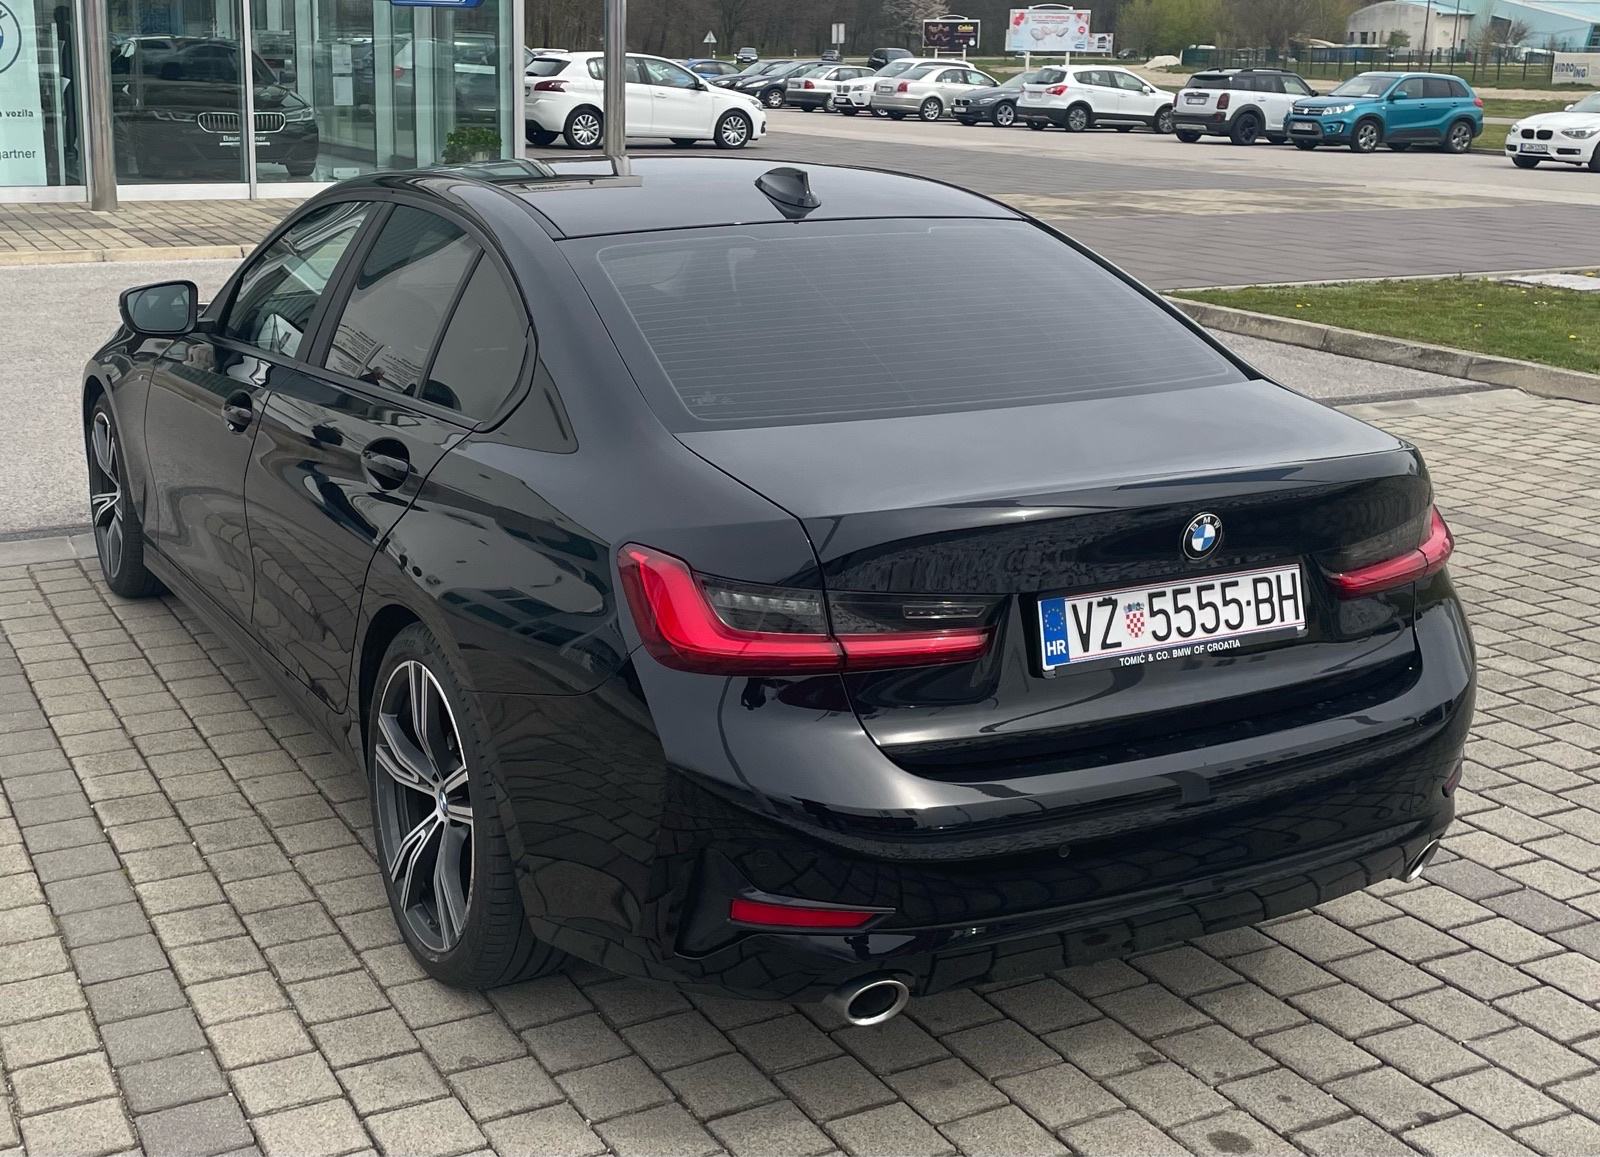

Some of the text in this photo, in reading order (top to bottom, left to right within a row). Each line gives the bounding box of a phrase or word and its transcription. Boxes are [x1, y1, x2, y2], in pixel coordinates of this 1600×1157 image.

[5, 109, 33, 117] vozila
[0, 149, 36, 160] artner
[1190, 517, 1221, 532] BMW
[1071, 597, 1122, 653] VŽ
[1046, 640, 1066, 656] HR
[1148, 653, 1154, 661] &
[1156, 651, 1170, 660] CO.
[1172, 647, 1191, 658] BMW
[1194, 645, 1204, 654] OF
[1207, 639, 1240, 652] CROATIA
